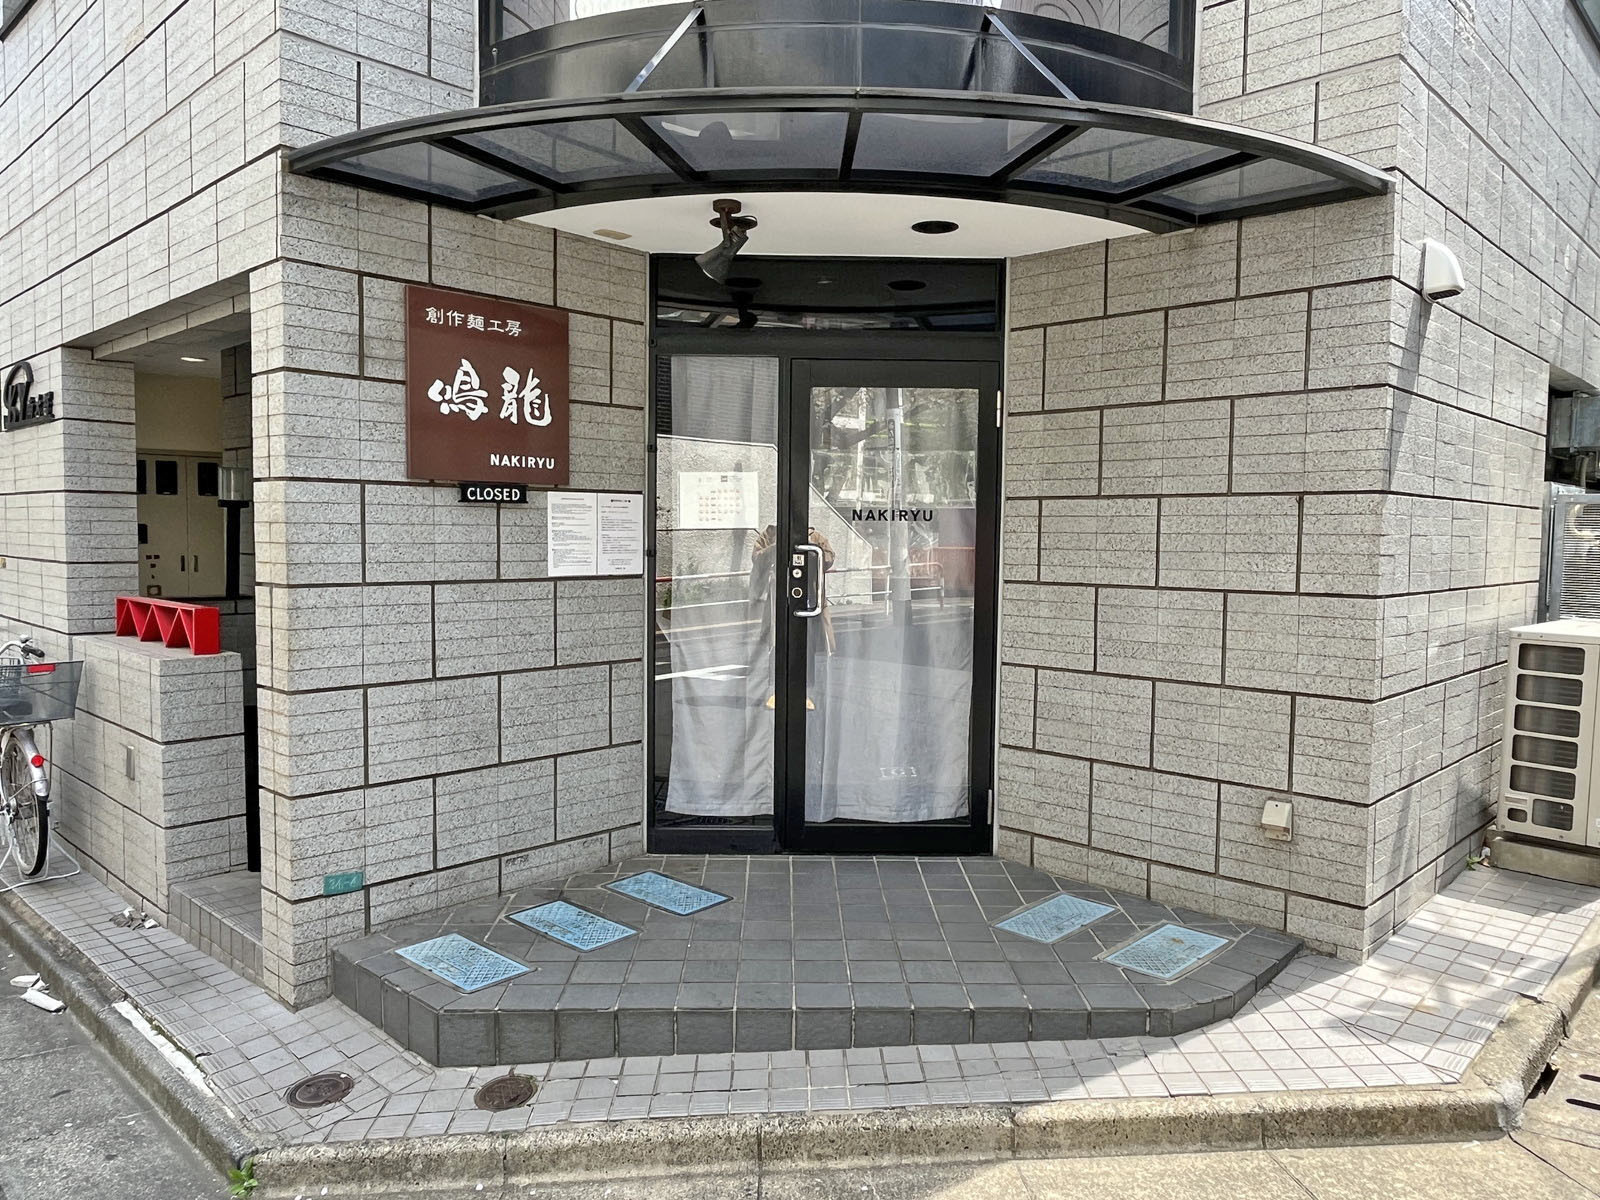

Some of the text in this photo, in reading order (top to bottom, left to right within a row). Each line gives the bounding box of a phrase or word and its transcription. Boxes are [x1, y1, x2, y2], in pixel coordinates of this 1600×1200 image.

[427, 358, 553, 427] 鳴龍
[490, 453, 555, 470] NAKIRYU
[467, 487, 520, 501] CLOSED
[852, 509, 933, 522] NAKIRYU
